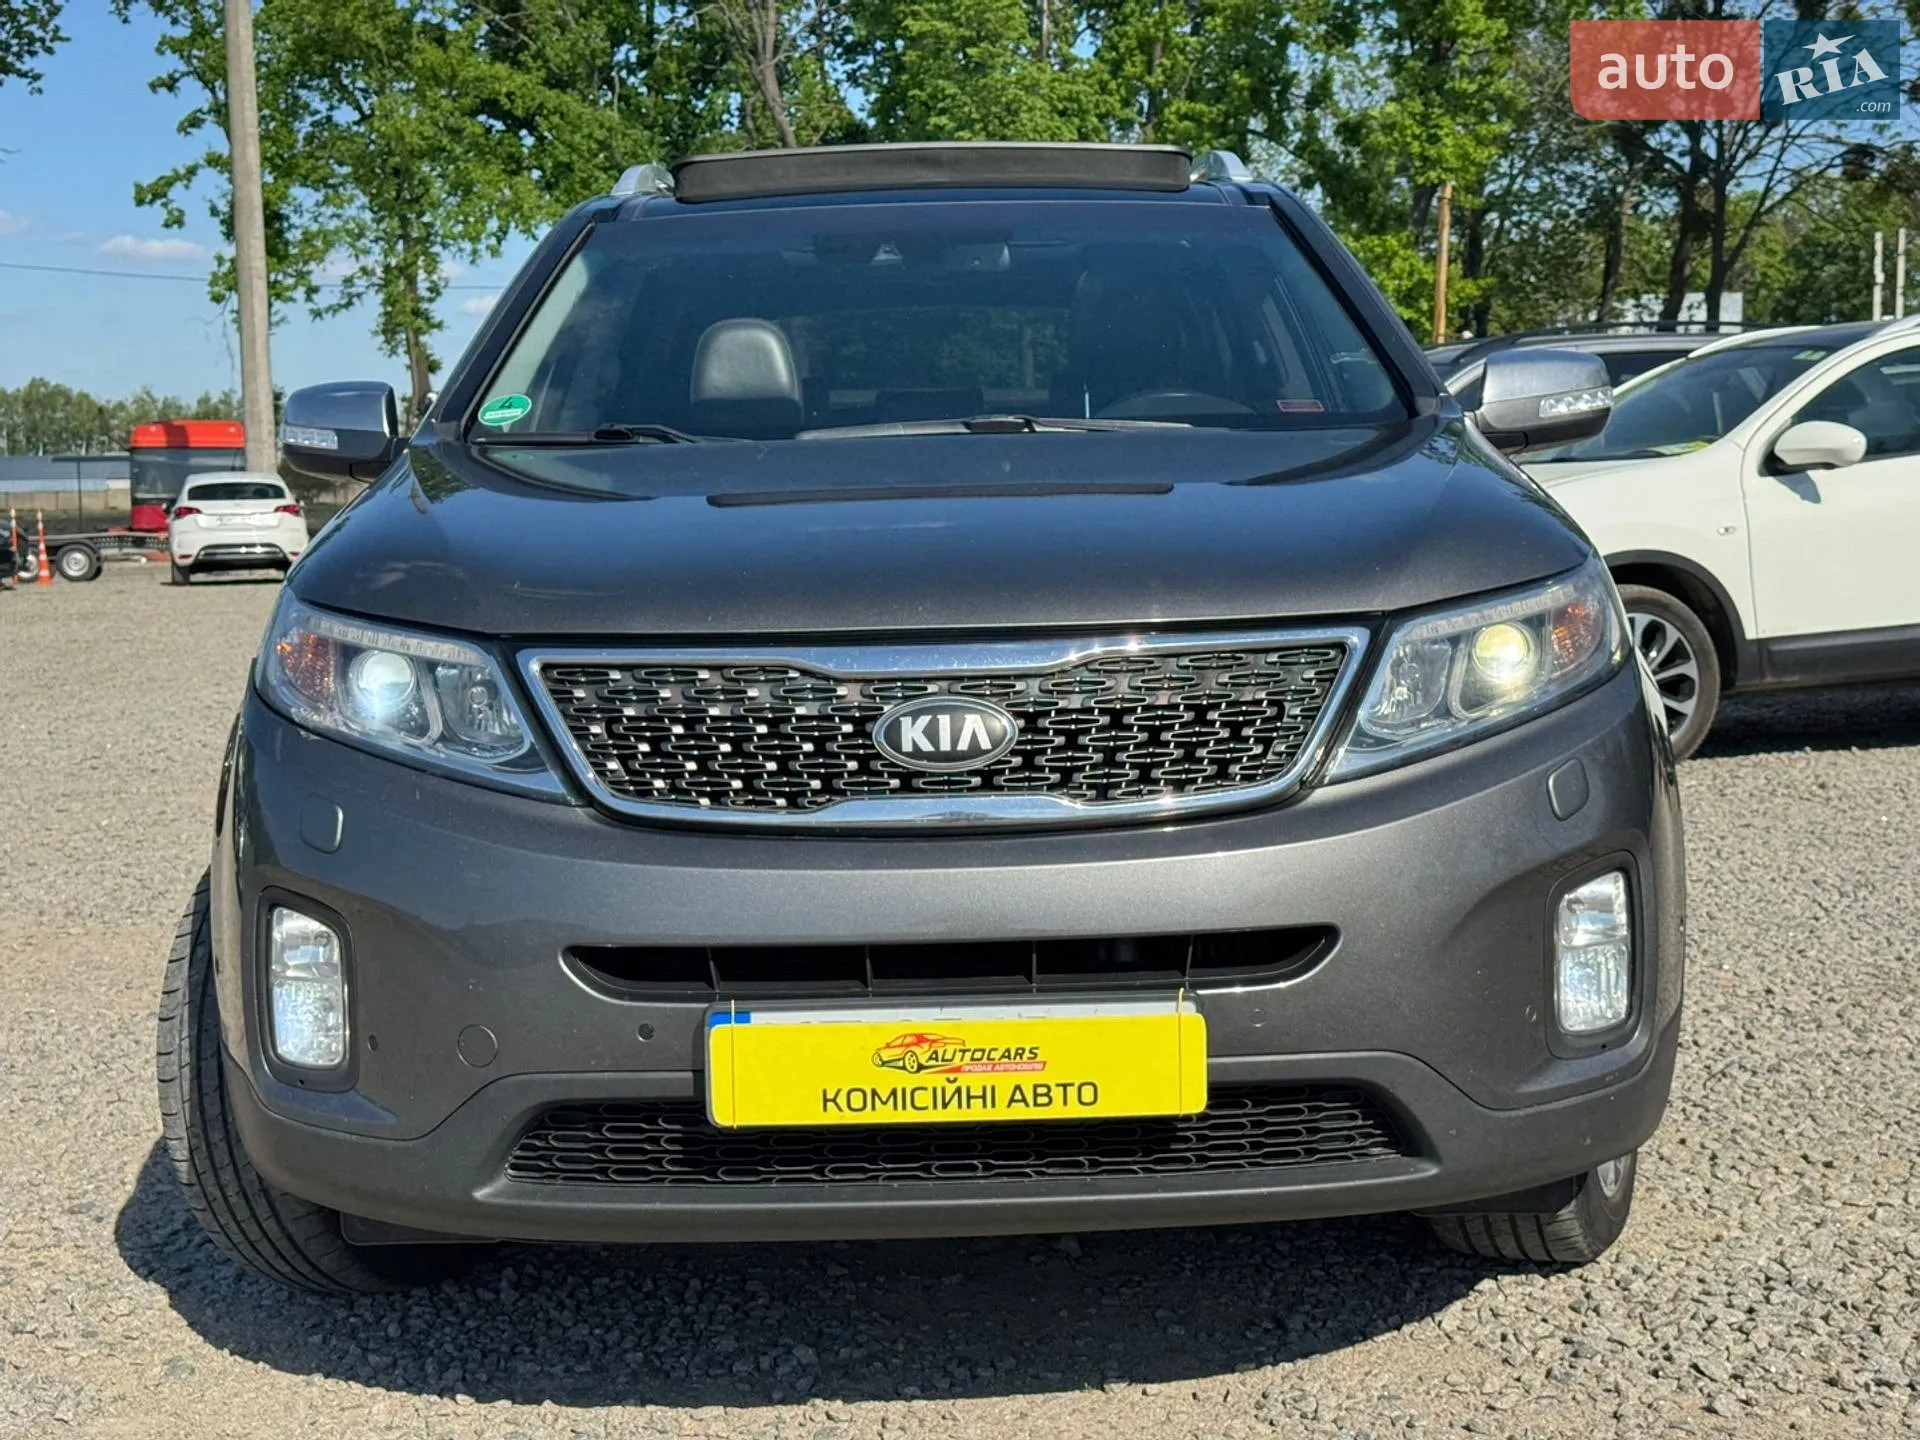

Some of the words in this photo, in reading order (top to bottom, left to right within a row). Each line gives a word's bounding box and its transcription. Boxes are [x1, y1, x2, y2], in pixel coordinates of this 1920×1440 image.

[899, 714, 992, 752] KIA
[925, 1047, 1039, 1063] AUTOCARS
[822, 1077, 996, 1113] КОМІСІЙНІ
[1006, 1081, 1099, 1108] АВТО
